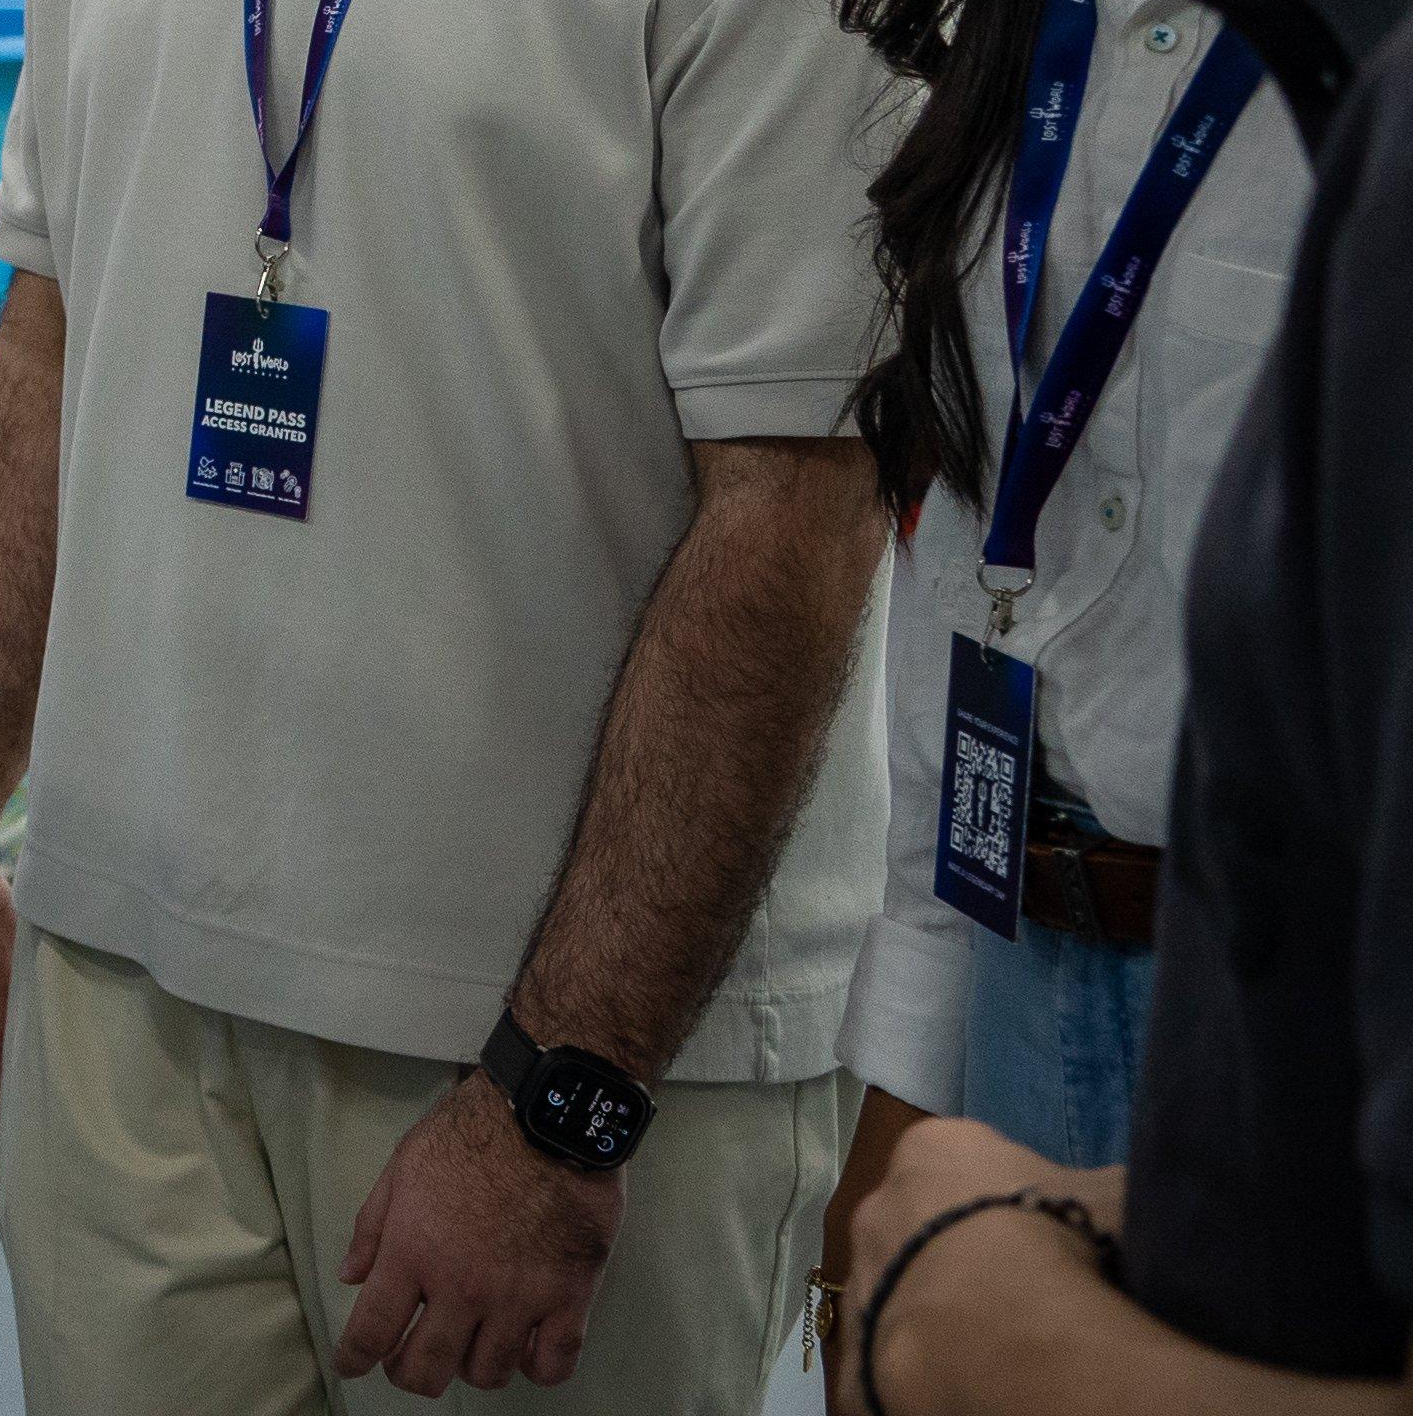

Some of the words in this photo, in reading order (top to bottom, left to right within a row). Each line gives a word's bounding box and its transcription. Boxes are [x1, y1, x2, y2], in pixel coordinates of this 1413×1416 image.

[1048, 80, 1064, 111] WORLD
[1041, 120, 1059, 142] LOST
[231, 350, 253, 367] LOST
[260, 354, 290, 372] WORLD
[205, 397, 266, 421] LEGEND
[267, 408, 306, 428] PASS
[201, 414, 247, 433] ACCESS
[249, 423, 307, 443] GRANTED
[585, 1100, 613, 1137] 9:34
